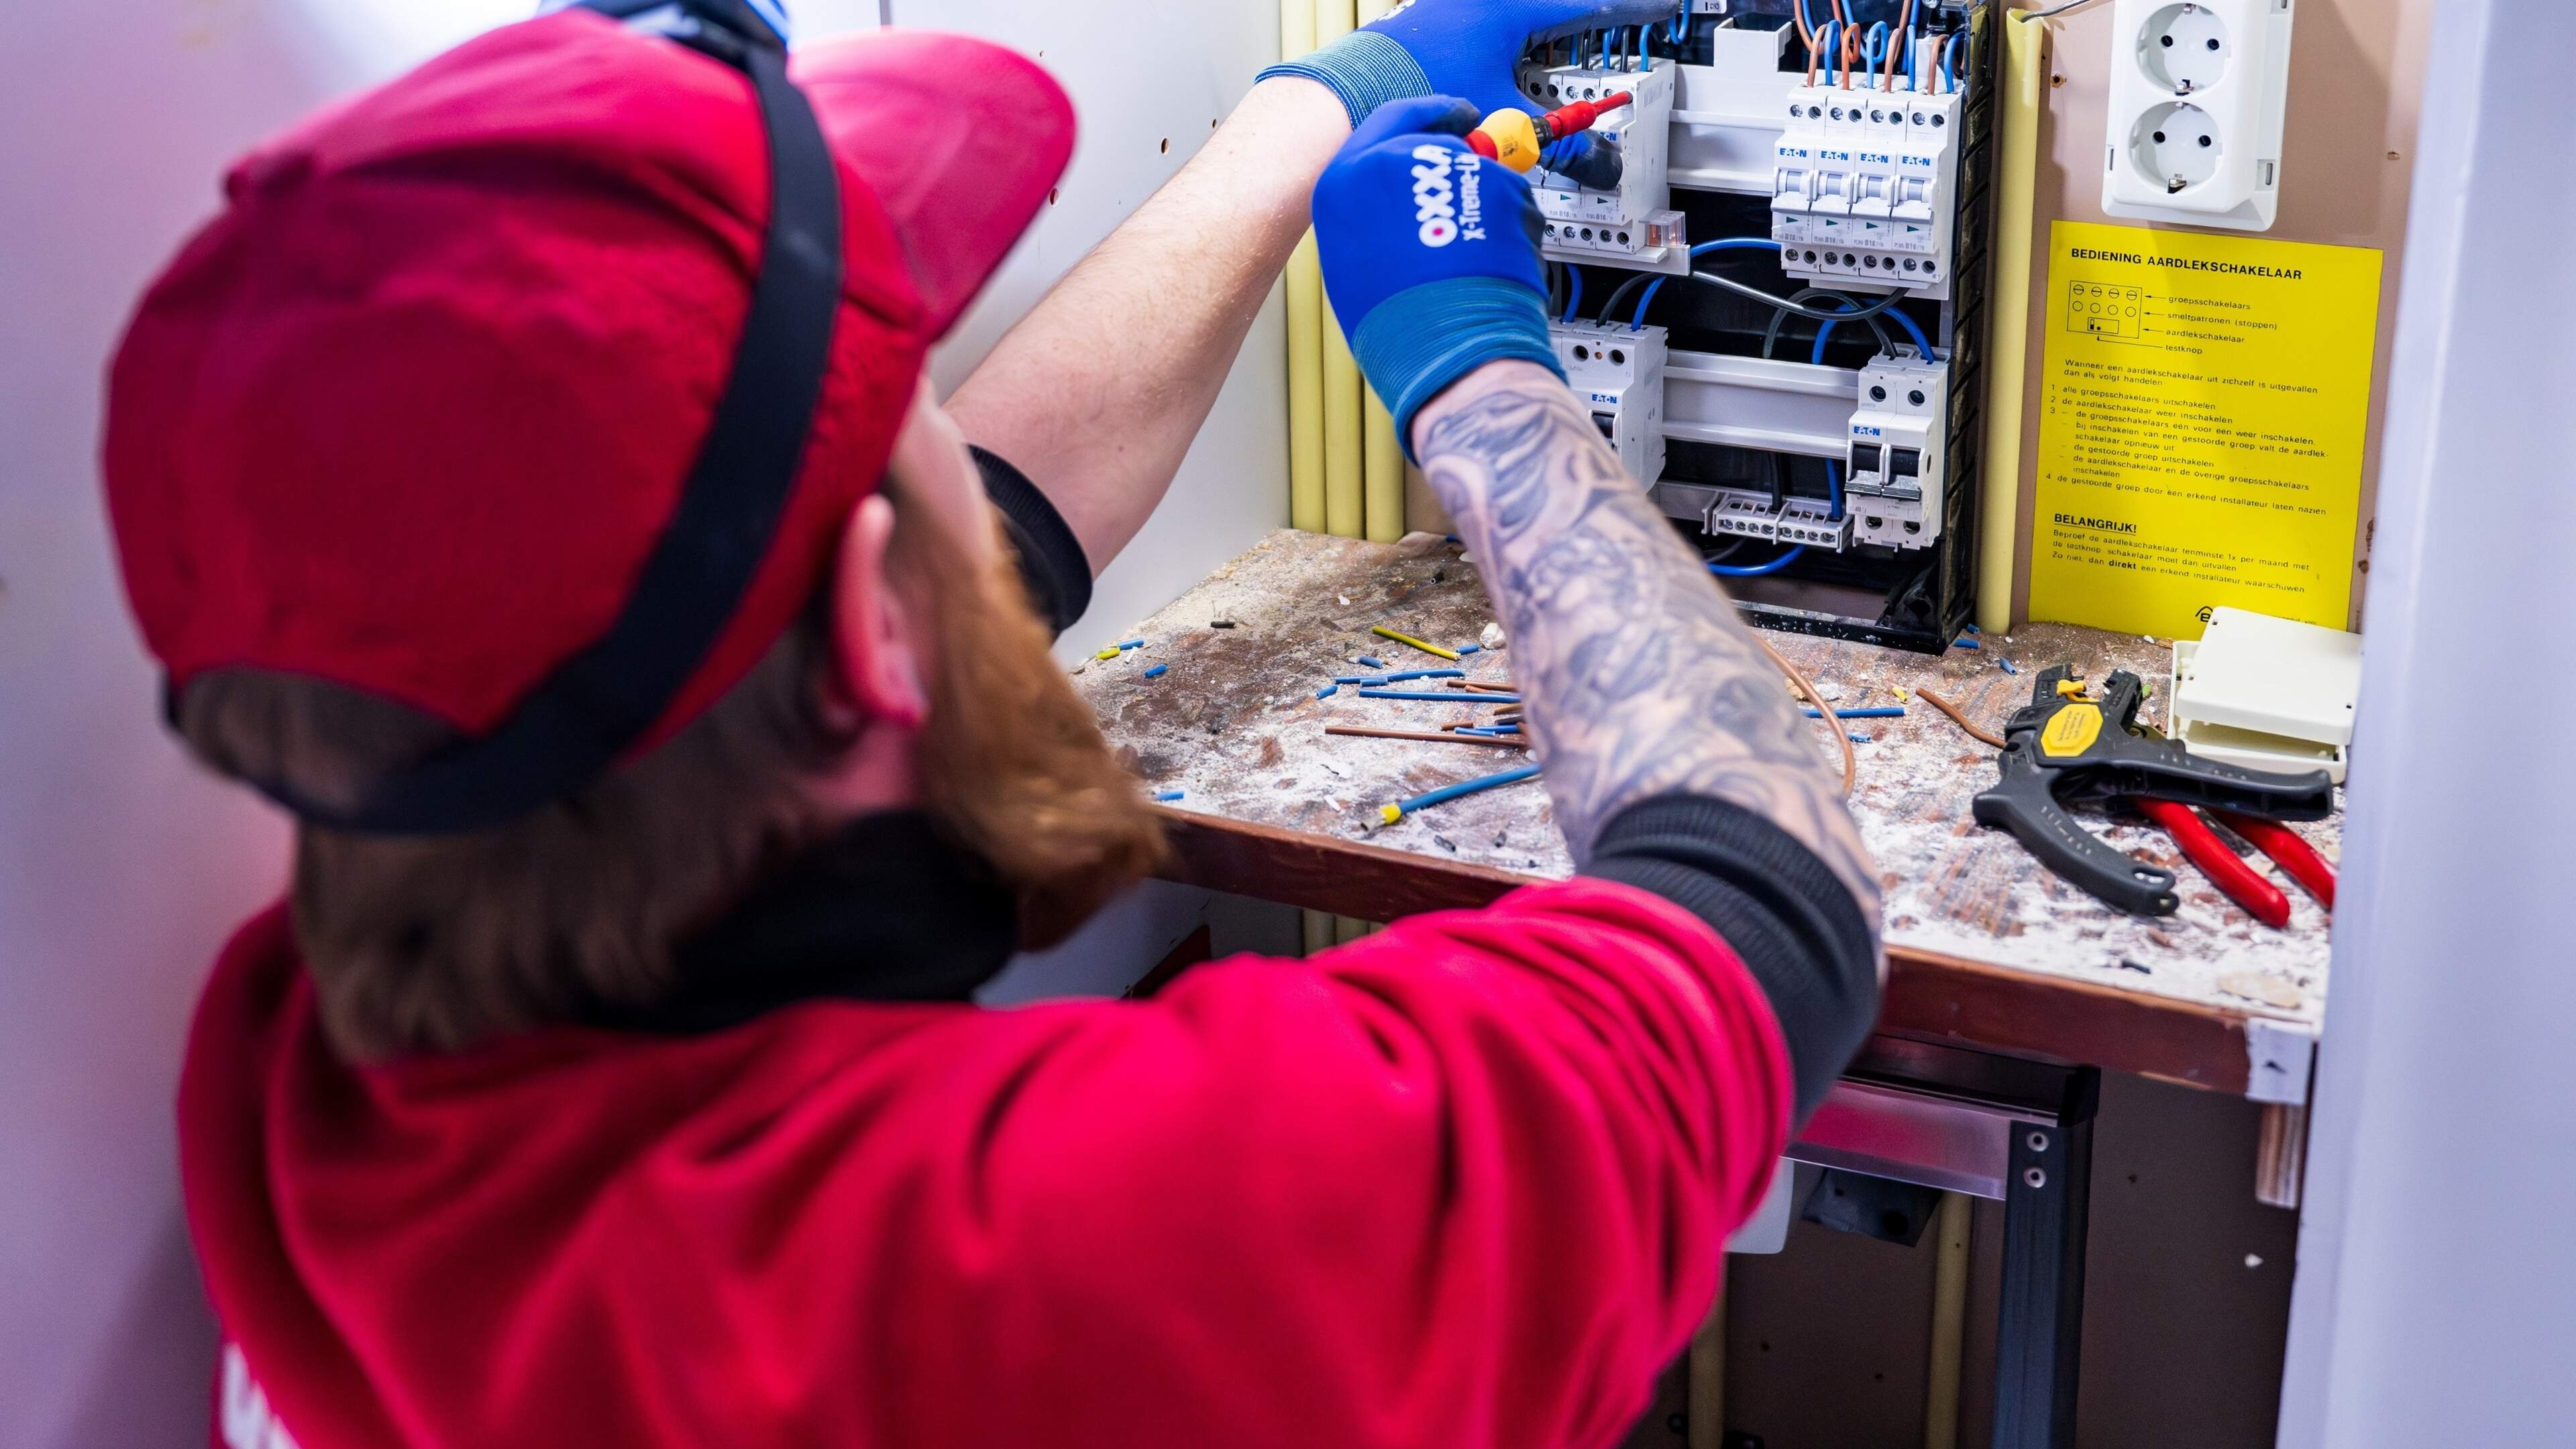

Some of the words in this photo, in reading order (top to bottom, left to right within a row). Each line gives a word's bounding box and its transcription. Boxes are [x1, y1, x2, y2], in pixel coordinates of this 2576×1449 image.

[1780, 148, 1807, 158] EATON
[1821, 150, 1848, 160] EATON
[1860, 154, 1888, 163] EATON
[1902, 156, 1930, 166] EATON
[1411, 144, 1458, 248] OXXA
[2072, 248, 2141, 264] BEDIENING
[2147, 256, 2302, 280] AARDLEKSCHAKELAAR
[2168, 295, 2251, 310] groepsschakelaars
[2167, 312, 2231, 325] smeltpatronen
[2235, 319, 2277, 330] (stoppen)
[2166, 329, 2245, 343] aardlekschakelaar
[2165, 344, 2202, 354] testknop
[2063, 368, 2080, 376] dan
[2083, 371, 2095, 379] als
[2098, 373, 2120, 382] volgt
[2123, 376, 2163, 386] handelen
[2065, 359, 2104, 369] Wanneer
[2127, 368, 2203, 381] aardlekschakelaar
[2222, 378, 2254, 386] zichzelf
[2270, 384, 2318, 394] uitgevallen
[1592, 394, 1617, 404] EATON
[2080, 389, 2159, 404] groepsschakelaars
[2163, 399, 2216, 410] uitschakelen
[2062, 397, 2073, 405] de
[2077, 400, 2153, 415] aardlekschakelaar
[2181, 413, 2233, 425] inschakelen
[1854, 426, 1880, 436] EATON
[2090, 413, 2169, 428] groepsschakelaars
[2235, 431, 2257, 439] weer
[2076, 421, 2086, 431] bij
[2090, 425, 2139, 435] inschakelen
[2182, 436, 2226, 446] gestoorde
[2229, 441, 2255, 451] groep
[2278, 445, 2290, 454] de
[2076, 433, 2120, 444] schakelaar
[2124, 440, 2160, 449] opnieuw
[2088, 446, 2131, 458] gestoorde
[2134, 453, 2158, 462] groep
[2161, 456, 2214, 468] uitschakelen
[2074, 467, 2121, 478] inschakelen
[2087, 458, 2162, 472] aardlekschakelaar
[2180, 468, 2190, 476] de
[2194, 471, 2225, 481] overige
[2229, 476, 2310, 490] groepsschakelaars
[2072, 478, 2112, 488] gestoorde
[2116, 484, 2140, 492] groep
[2143, 485, 2163, 494] door
[2167, 490, 2183, 498] een
[2186, 492, 2216, 502] erkend
[2220, 496, 2268, 508] installateur
[2272, 502, 2294, 511] laten
[2298, 506, 2326, 515] nazien
[2054, 513, 2137, 533] BELANGRIJK!
[2053, 529, 2085, 540] Beproef
[2103, 539, 2178, 553] aardlekschakelaar
[2182, 548, 2224, 559] tenminste
[2240, 556, 2255, 564] per
[2259, 559, 2289, 568] maand
[2053, 539, 2063, 547] de
[2067, 543, 2101, 553] testknop
[2107, 549, 2153, 560] schakelaar
[2157, 556, 2178, 565] moet
[2182, 558, 2198, 567] dan
[2202, 562, 2237, 572] uitvallen
[2052, 551, 2063, 559] Zo
[2088, 557, 2104, 565] dan
[2108, 559, 2137, 570] direkt
[2141, 565, 2157, 573] een
[2160, 568, 2190, 577] erkend
[2193, 573, 2241, 584] installateur
[2245, 580, 2305, 593] waarschuwen
